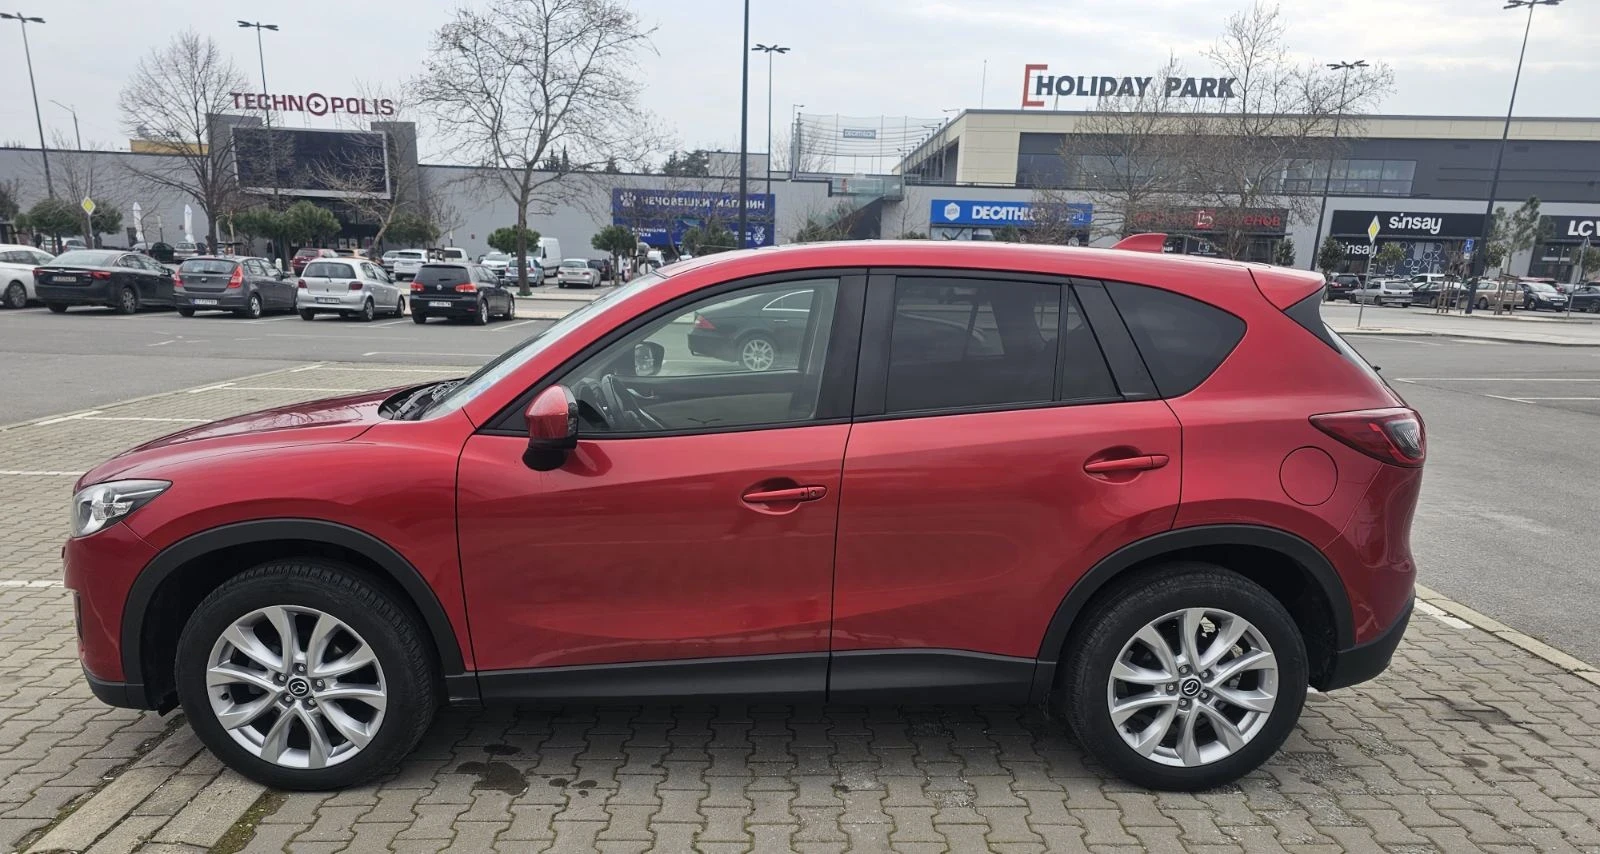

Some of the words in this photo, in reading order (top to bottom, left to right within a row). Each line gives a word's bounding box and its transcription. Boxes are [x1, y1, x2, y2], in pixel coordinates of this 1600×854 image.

[1036, 75, 1152, 97] HOLIDAY
[1164, 77, 1237, 98] PARK
[715, 199, 765, 209] МАГИН
[1389, 213, 1442, 235] sinsay
